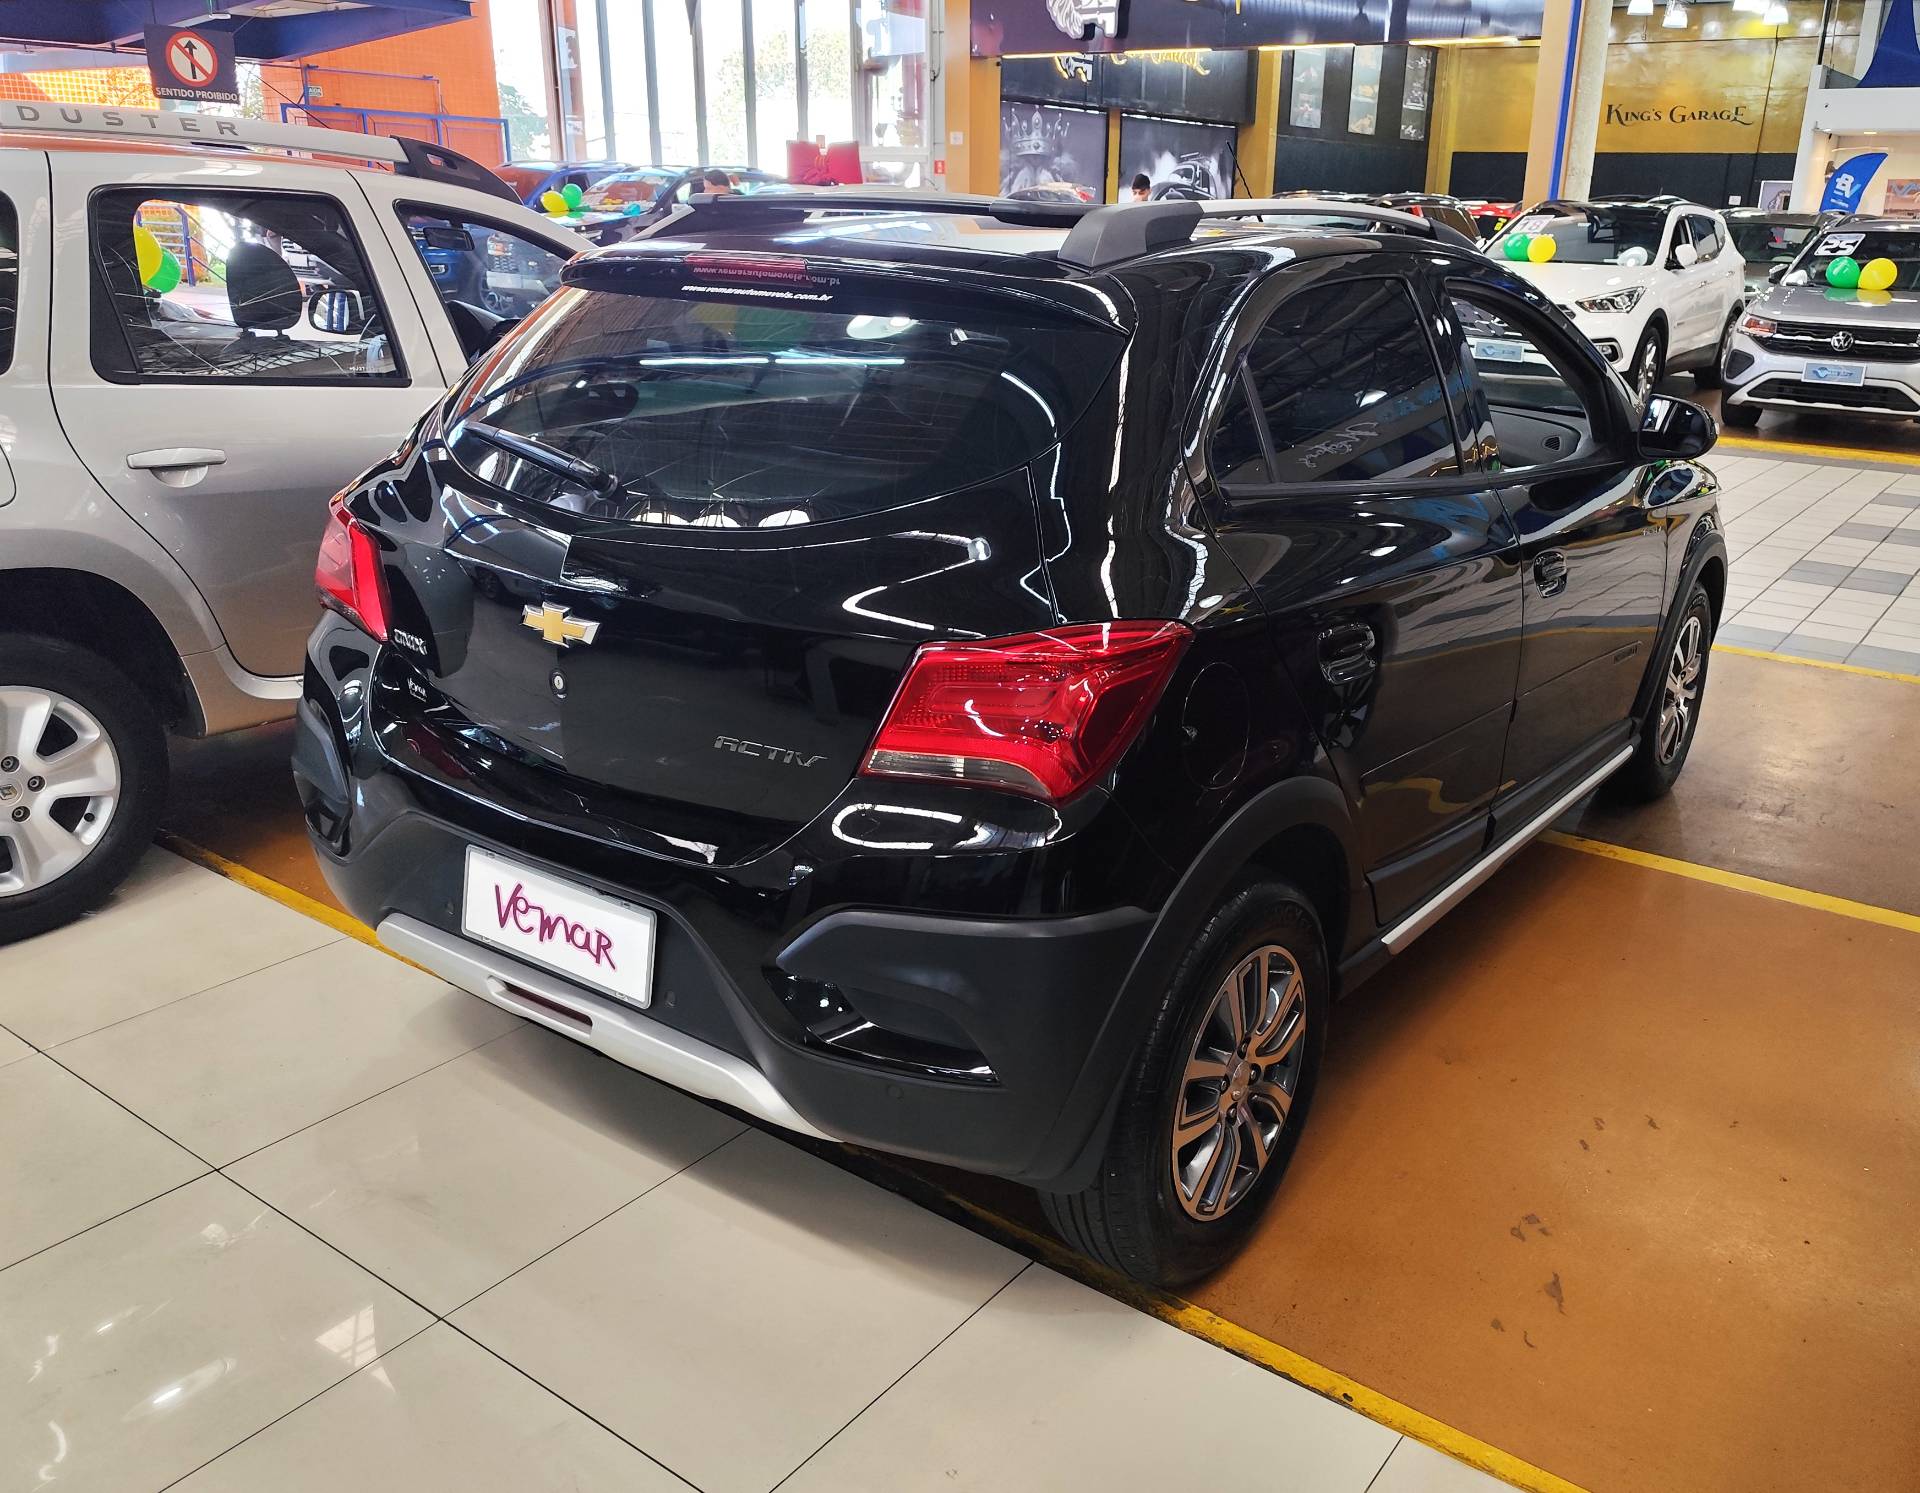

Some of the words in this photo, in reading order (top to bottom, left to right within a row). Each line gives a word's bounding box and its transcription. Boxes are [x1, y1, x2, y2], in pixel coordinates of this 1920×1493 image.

[155, 87, 194, 99] SENTIDO
[195, 90, 238, 102] PROIBIDO
[16, 105, 239, 136] DUSTER
[1823, 240, 1858, 254] 25
[714, 735, 829, 767] ACTIV
